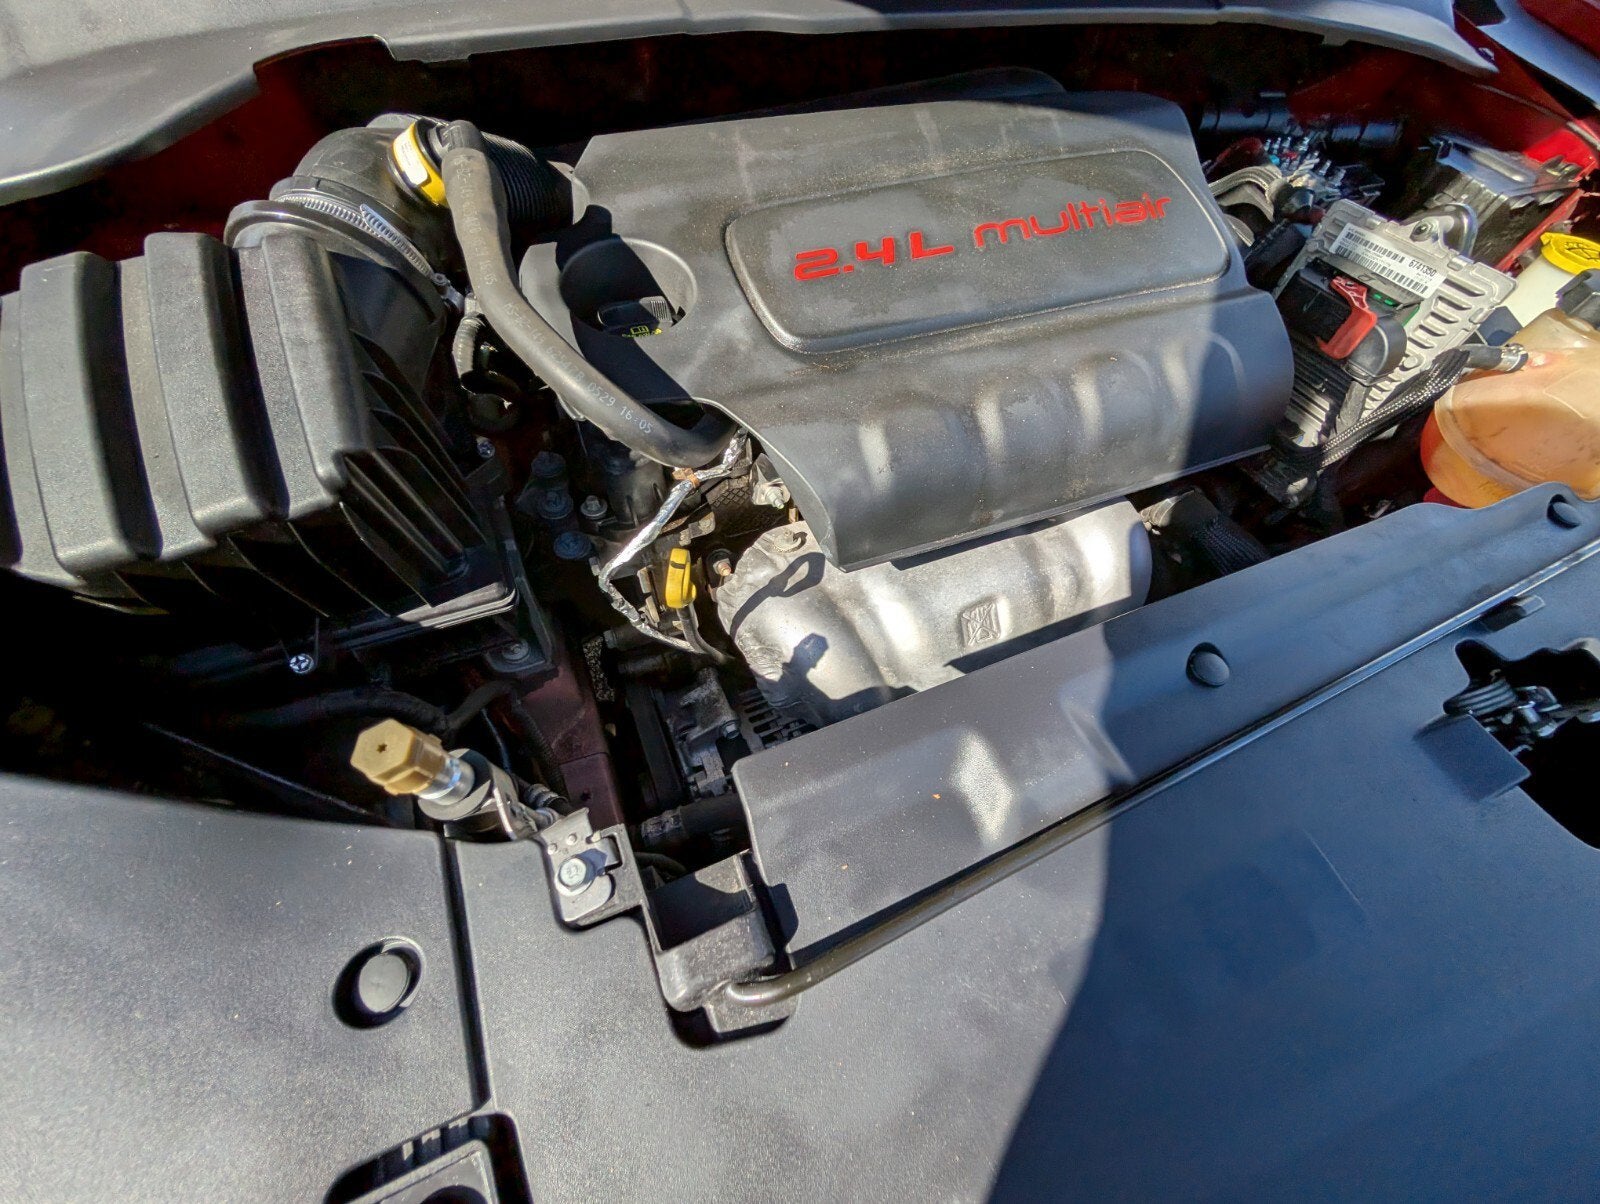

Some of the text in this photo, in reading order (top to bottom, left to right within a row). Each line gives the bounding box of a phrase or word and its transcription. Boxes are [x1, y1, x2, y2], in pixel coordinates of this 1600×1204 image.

[973, 193, 1172, 248] multiair
[1408, 259, 1437, 277] 6741350
[587, 382, 616, 407] 0529
